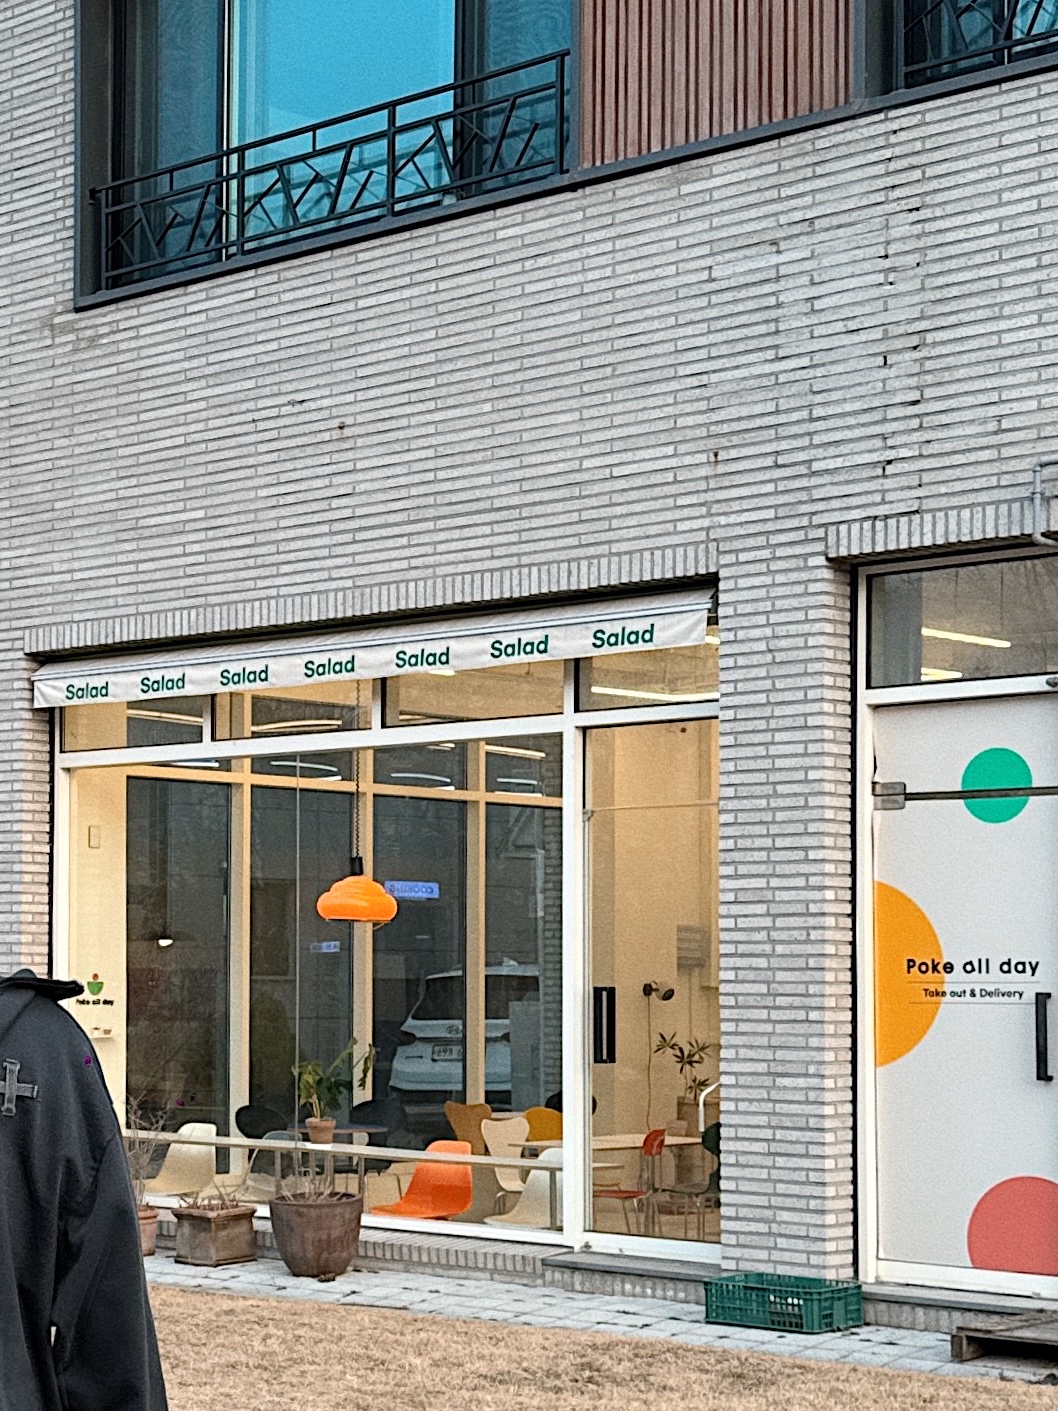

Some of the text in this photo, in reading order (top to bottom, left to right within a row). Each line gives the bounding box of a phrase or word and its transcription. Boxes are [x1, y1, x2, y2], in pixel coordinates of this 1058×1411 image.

[66, 623, 655, 700] Salad Salad Salad Salad Salad Salad Salad
[906, 957, 1040, 977] Poke all day
[922, 988, 1024, 1000] Take out & Delivery
